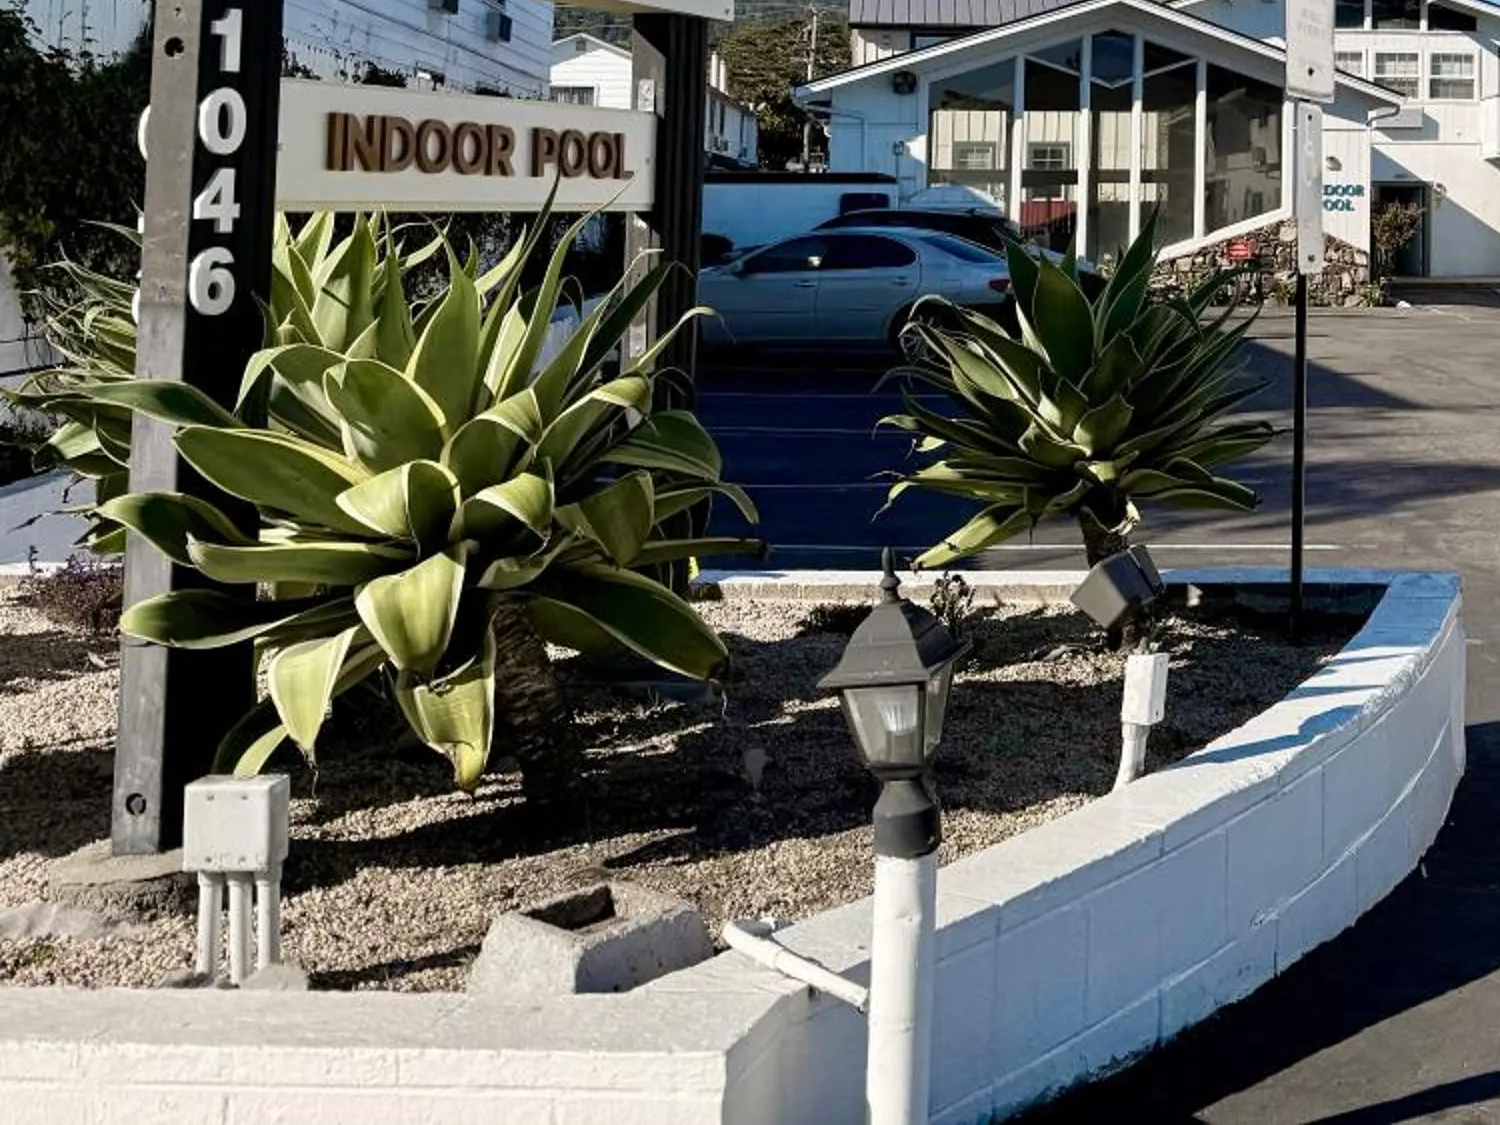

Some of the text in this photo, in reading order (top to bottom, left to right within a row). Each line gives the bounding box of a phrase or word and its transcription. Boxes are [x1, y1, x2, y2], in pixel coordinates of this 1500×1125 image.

[188, 8, 248, 317] 1046
[326, 110, 635, 181] INDOOR POOL
